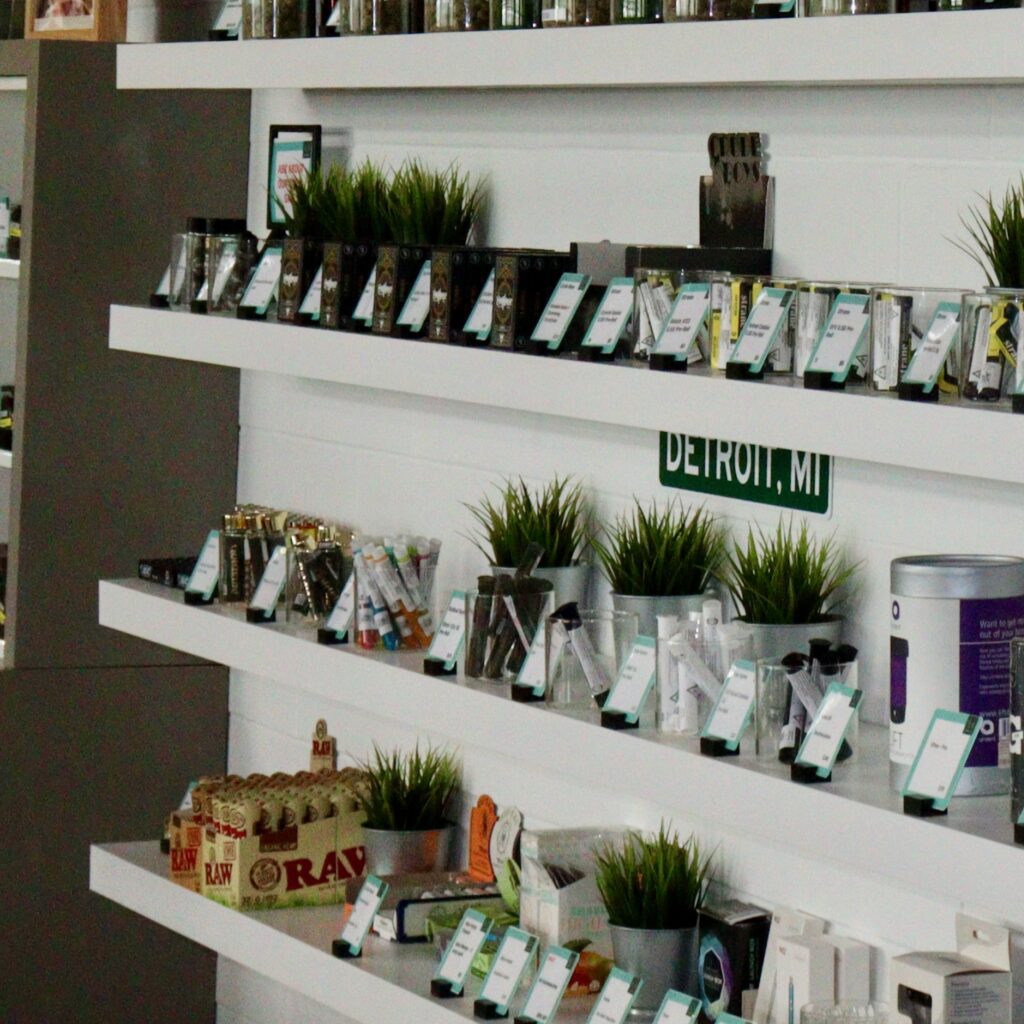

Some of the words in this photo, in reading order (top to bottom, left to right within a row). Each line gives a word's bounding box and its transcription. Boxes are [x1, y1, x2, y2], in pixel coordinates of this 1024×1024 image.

[666, 432, 783, 495] DETROIT,
[790, 451, 820, 497] MI
[171, 848, 198, 872] RAW
[205, 863, 233, 886] RAW
